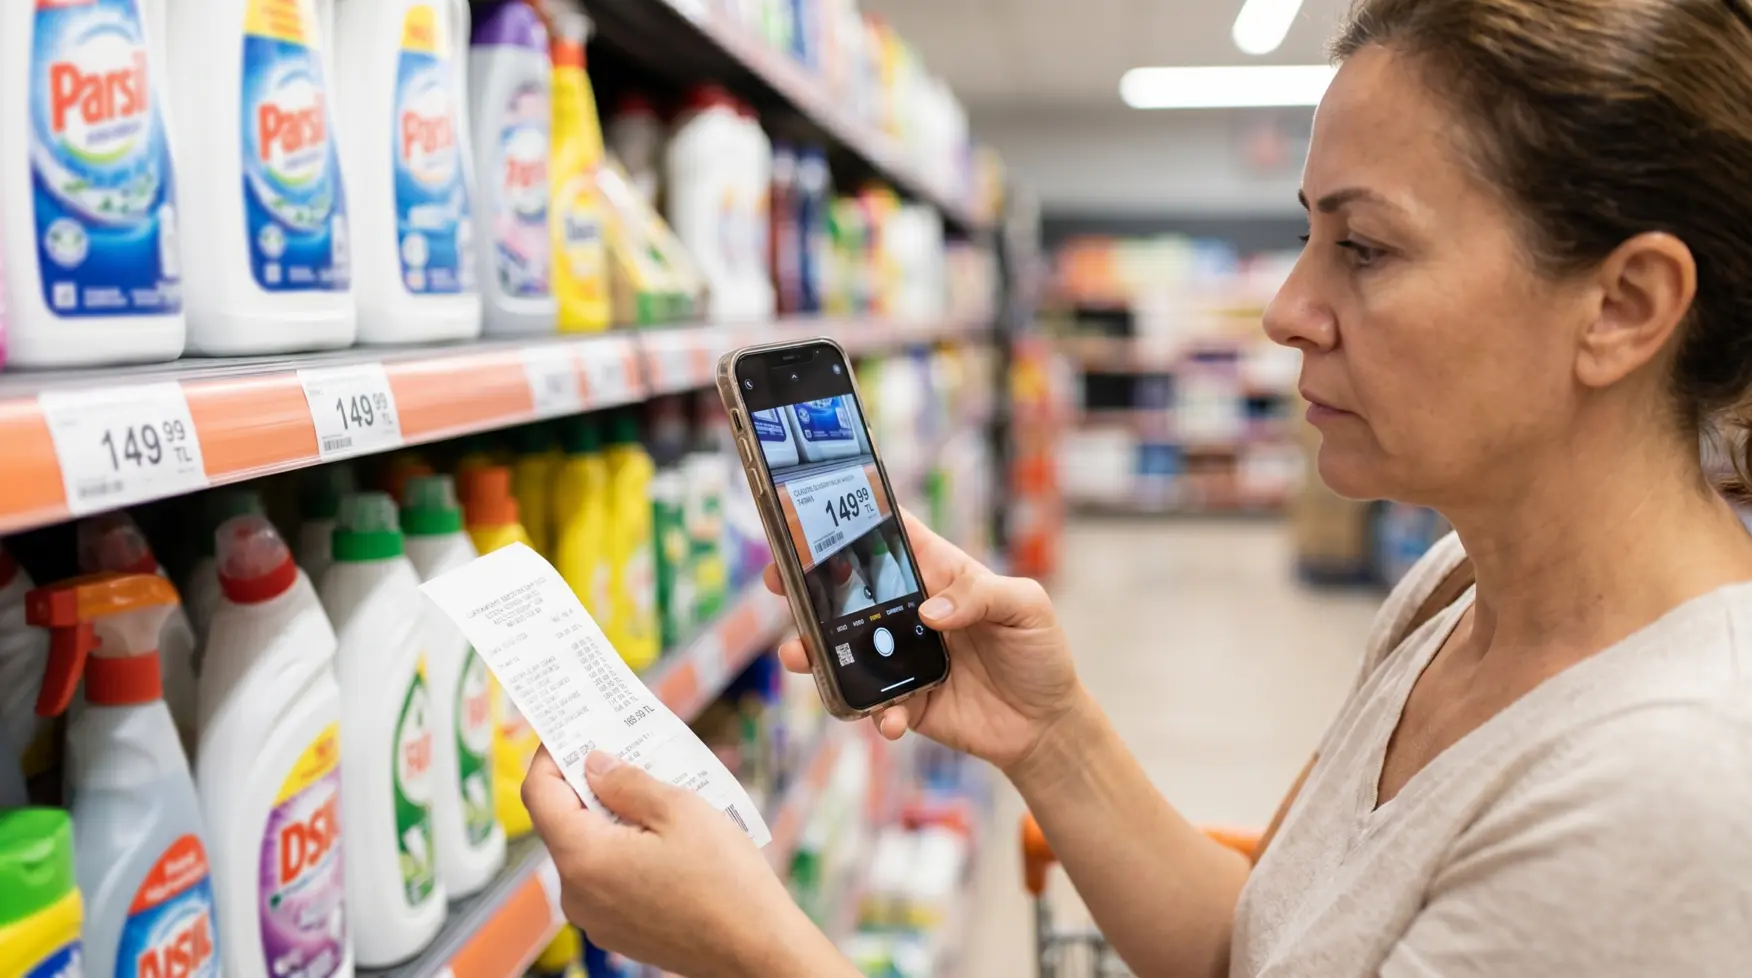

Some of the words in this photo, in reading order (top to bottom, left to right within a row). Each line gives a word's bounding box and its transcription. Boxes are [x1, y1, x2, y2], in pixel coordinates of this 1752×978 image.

[336, 394, 374, 430] 149
[373, 392, 388, 410] 99
[102, 423, 163, 472] 149
[163, 420, 187, 443] 99
[174, 446, 194, 463] TL
[825, 492, 860, 527] 149
[856, 487, 870, 503] 99
[864, 503, 875, 513] TL
